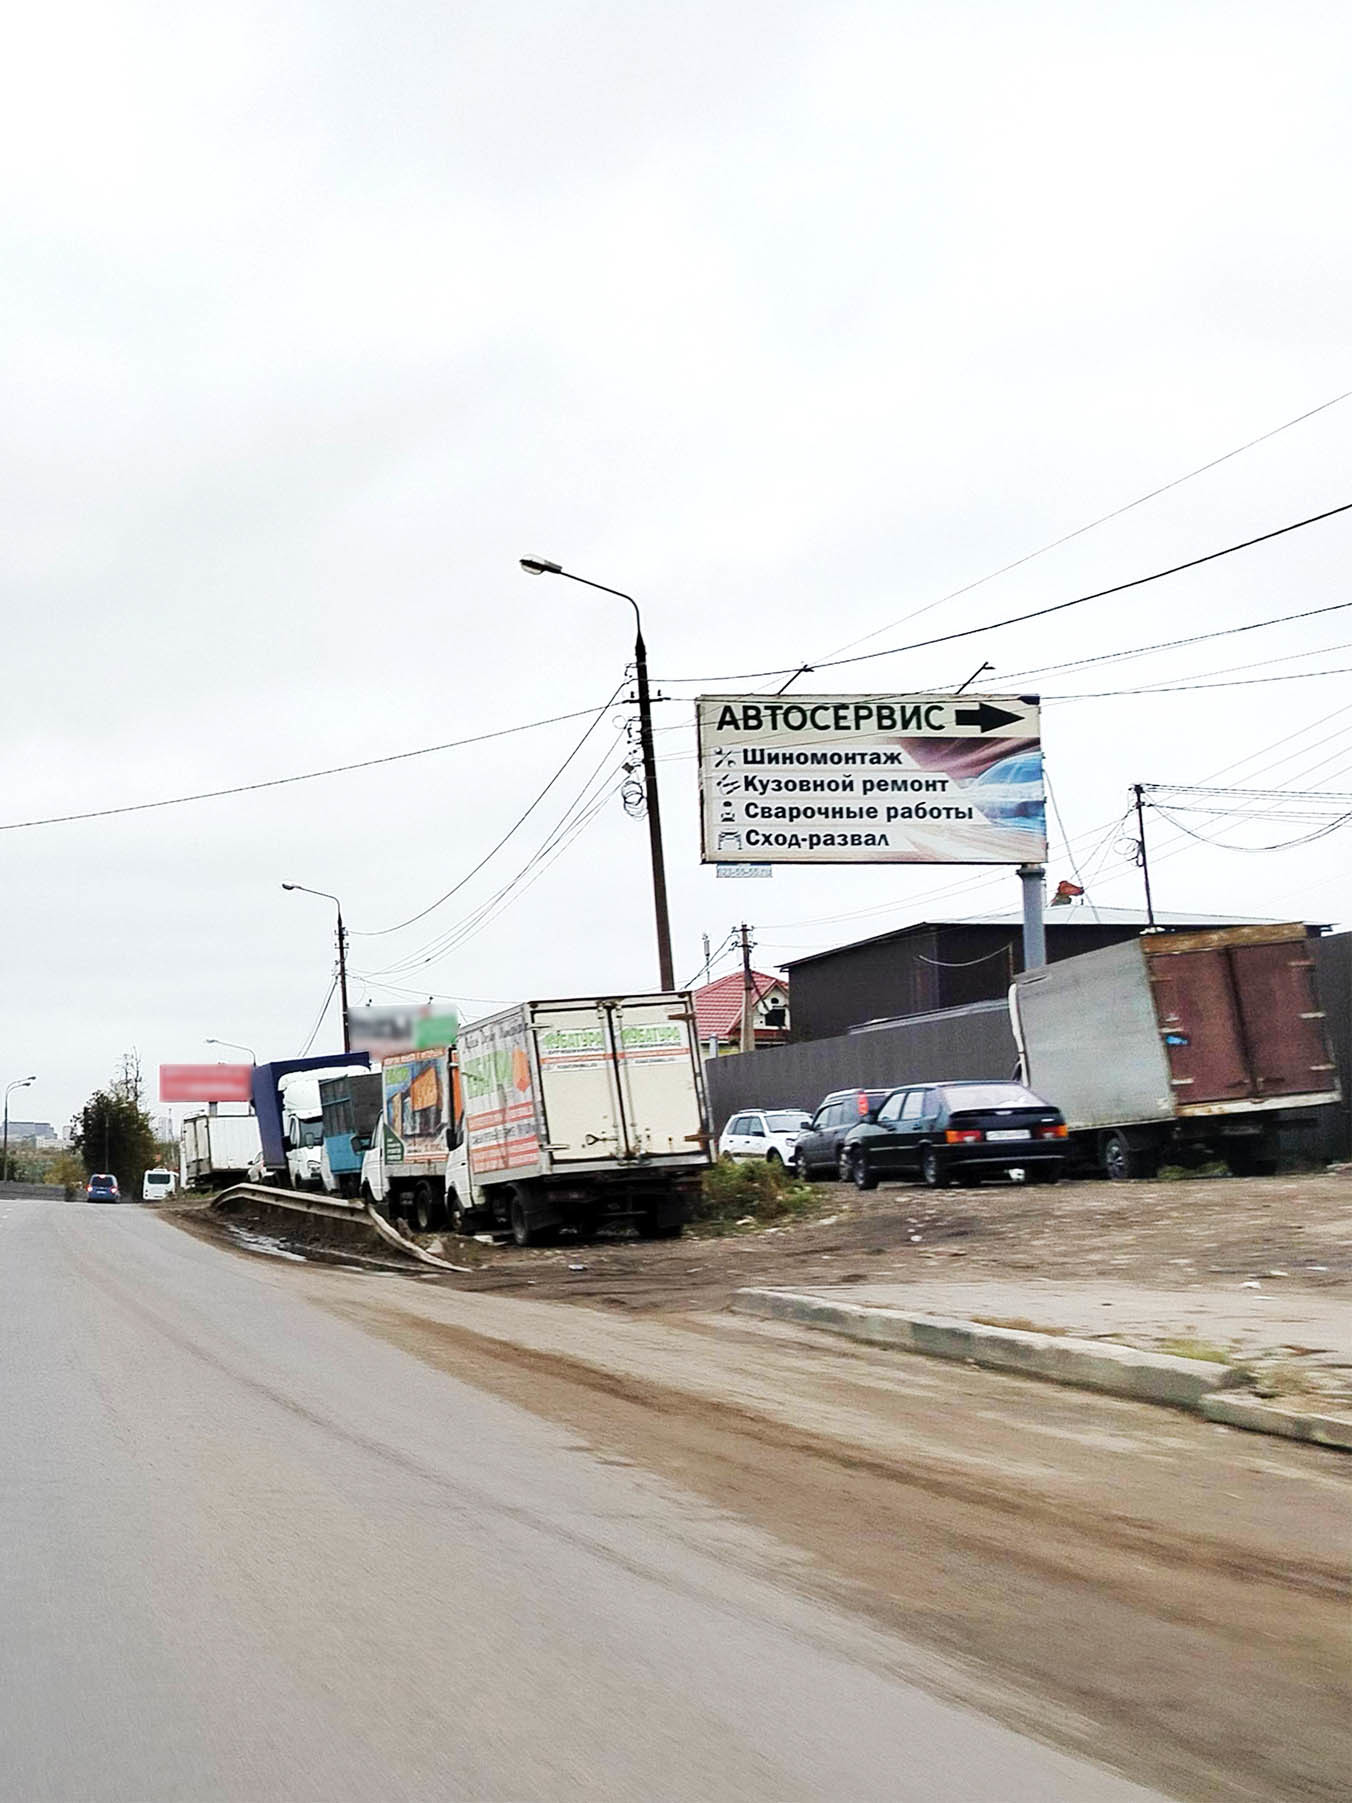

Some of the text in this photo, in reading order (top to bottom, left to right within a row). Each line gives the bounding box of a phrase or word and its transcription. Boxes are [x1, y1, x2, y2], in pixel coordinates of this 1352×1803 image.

[716, 704, 946, 731] АВТОСЕРВИС
[742, 748, 903, 766] Шиномонтаж
[743, 774, 949, 796] Кузовной ремонт
[744, 801, 973, 823] Сварочные работы
[745, 829, 890, 849] Сход-развал
